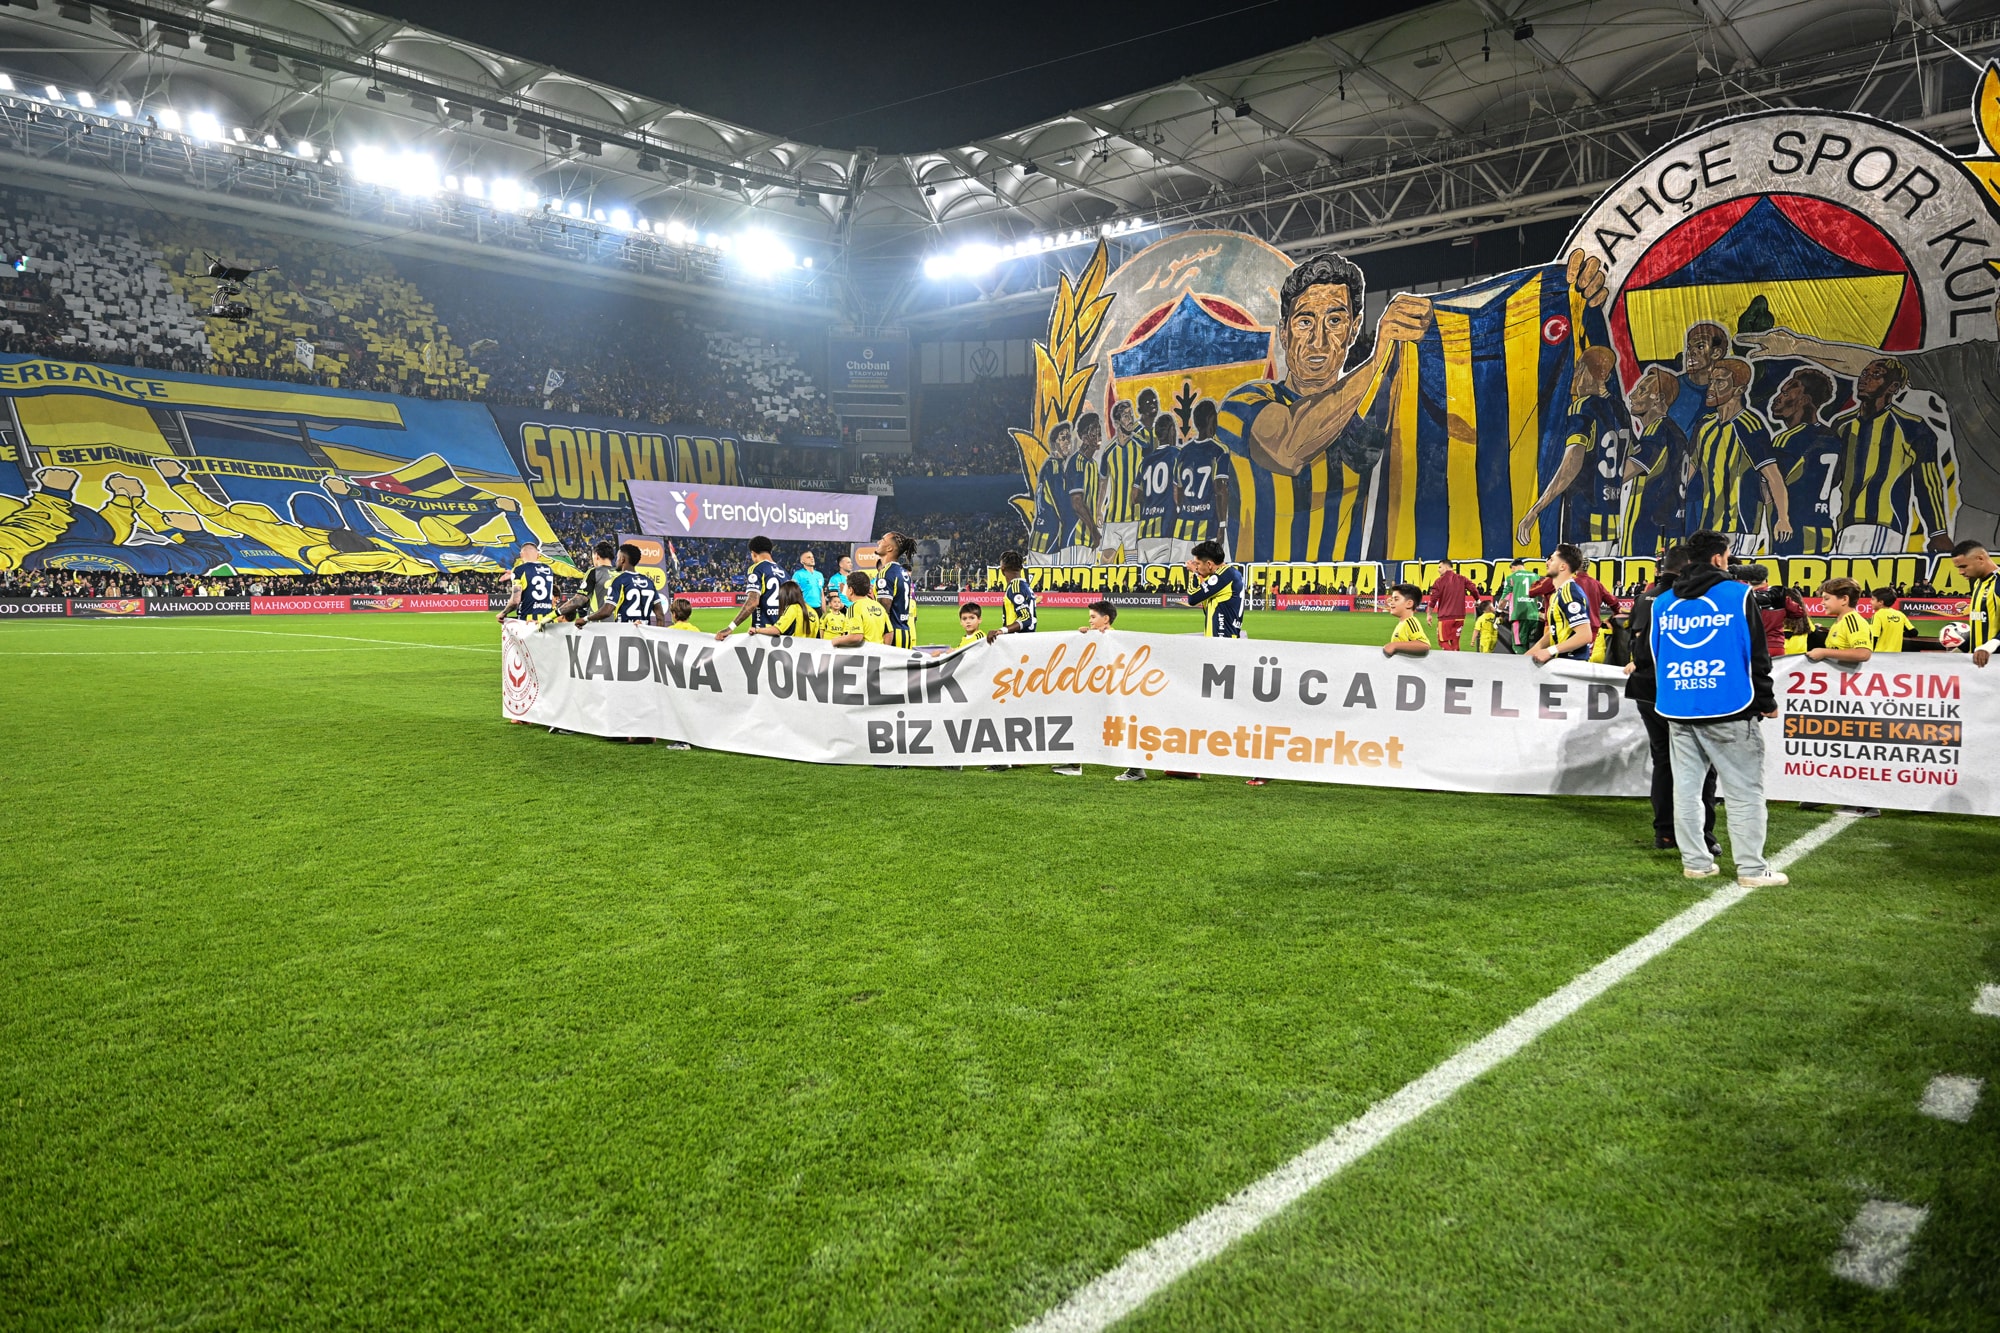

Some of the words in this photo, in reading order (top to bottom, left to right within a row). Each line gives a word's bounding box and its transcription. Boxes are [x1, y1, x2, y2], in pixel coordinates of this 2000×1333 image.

[1594, 140, 1738, 271] AHÇE
[1767, 130, 1941, 220] SPOR
[1926, 217, 1996, 338] KUL
[846, 360, 890, 371] Chobani
[1143, 461, 1169, 497] 10
[1181, 465, 1212, 499] 27
[1819, 453, 1839, 500] 7
[379, 493, 417, 509] 1907
[702, 498, 787, 528] trendyol
[409, 599, 459, 608] MAHMOOD
[460, 599, 488, 608] COFFEE
[625, 588, 656, 618] 27
[766, 576, 780, 607] 2
[1103, 596, 1139, 605] MAHMOOD
[1139, 597, 1161, 605] COFFEE
[21, 603, 64, 614] COFFEE
[149, 602, 214, 612] MAHMOOD
[215, 602, 250, 611] COFFEE
[253, 601, 312, 610] MAHMOOD
[313, 600, 345, 609] COFFEE
[1903, 603, 1953, 611] MAHMOOD
[1659, 611, 1734, 635] Bilyoner
[565, 634, 723, 693] KADINA
[733, 636, 969, 706] YÖNELİK
[991, 642, 1170, 704] şiddetle
[1200, 655, 1620, 721] MÜCADELED
[1666, 659, 1726, 679] 2682
[1674, 677, 1717, 691] PRESS
[1786, 671, 1828, 695] 25
[1839, 672, 1961, 700] KASIM
[1785, 698, 1865, 715] KADINA
[1870, 700, 1961, 719] YÖNELİK
[867, 710, 934, 755] BİZ
[943, 715, 1075, 754] VARIZ
[1102, 714, 1404, 769] #işaretiFarket
[1784, 715, 1882, 738] ŞİDDETE
[1888, 721, 1961, 745] KARŞI
[1784, 740, 1960, 765] ULUSLARARASI
[1784, 760, 1892, 782] MÜCADELE
[1897, 767, 1959, 786] GÜNÜ
